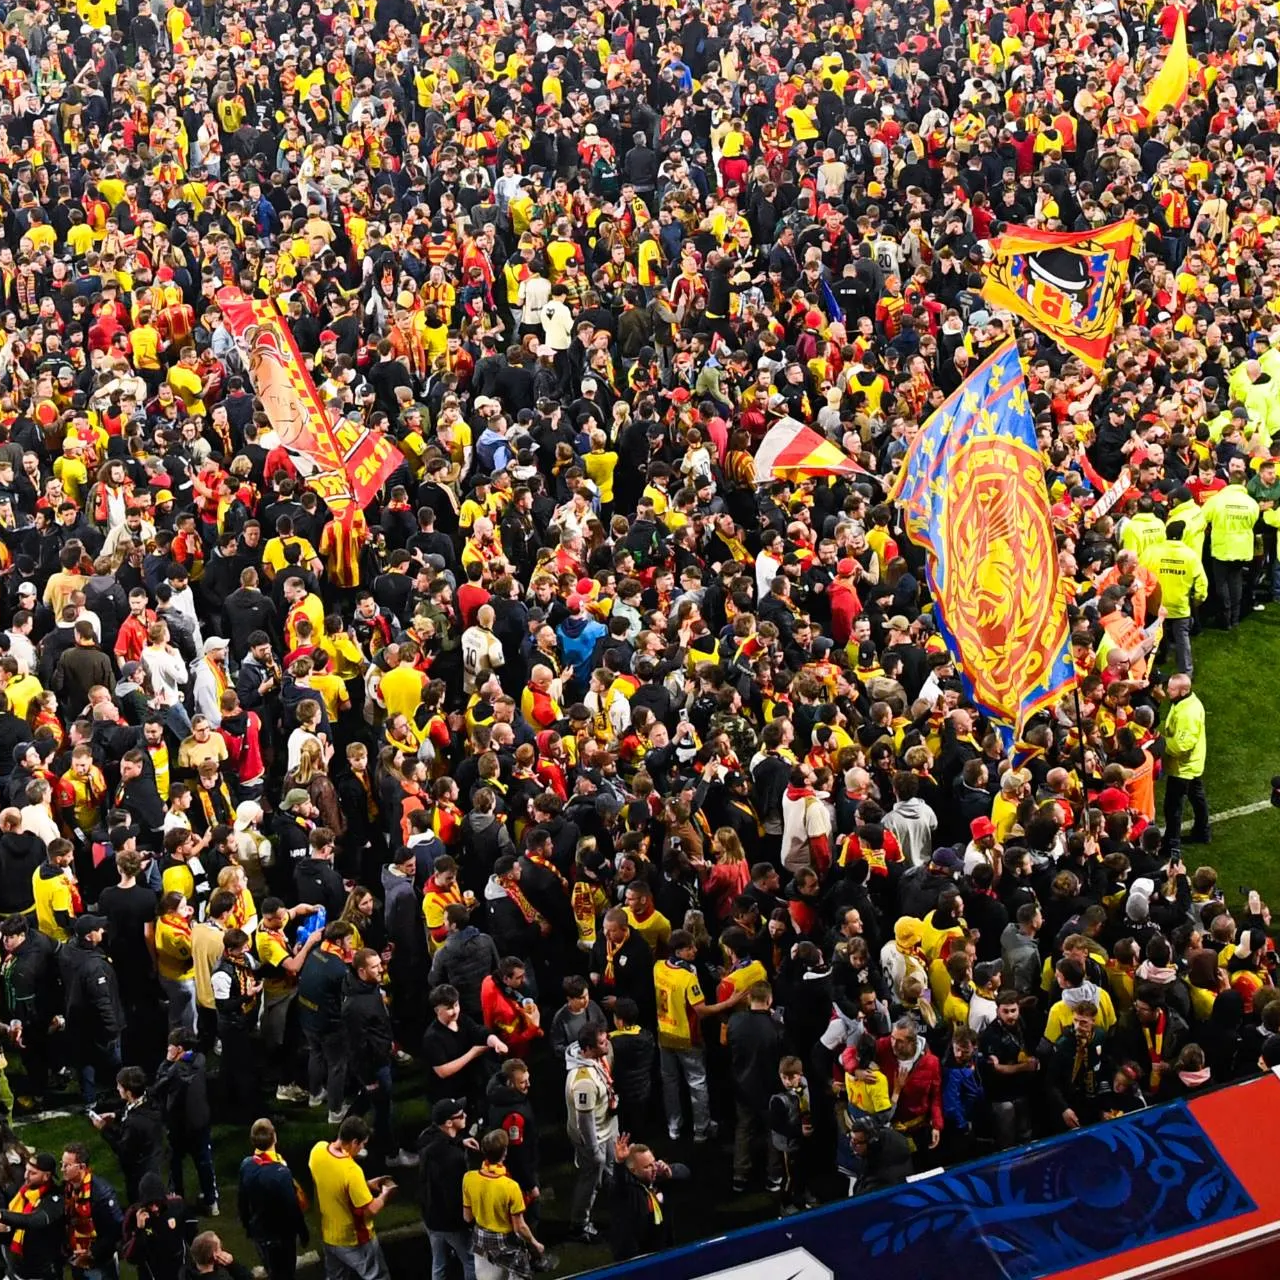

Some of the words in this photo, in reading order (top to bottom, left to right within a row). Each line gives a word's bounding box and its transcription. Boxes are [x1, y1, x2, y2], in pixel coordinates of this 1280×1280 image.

[878, 254, 892, 268] 20
[700, 461, 710, 476] 10
[466, 647, 477, 667] 10
